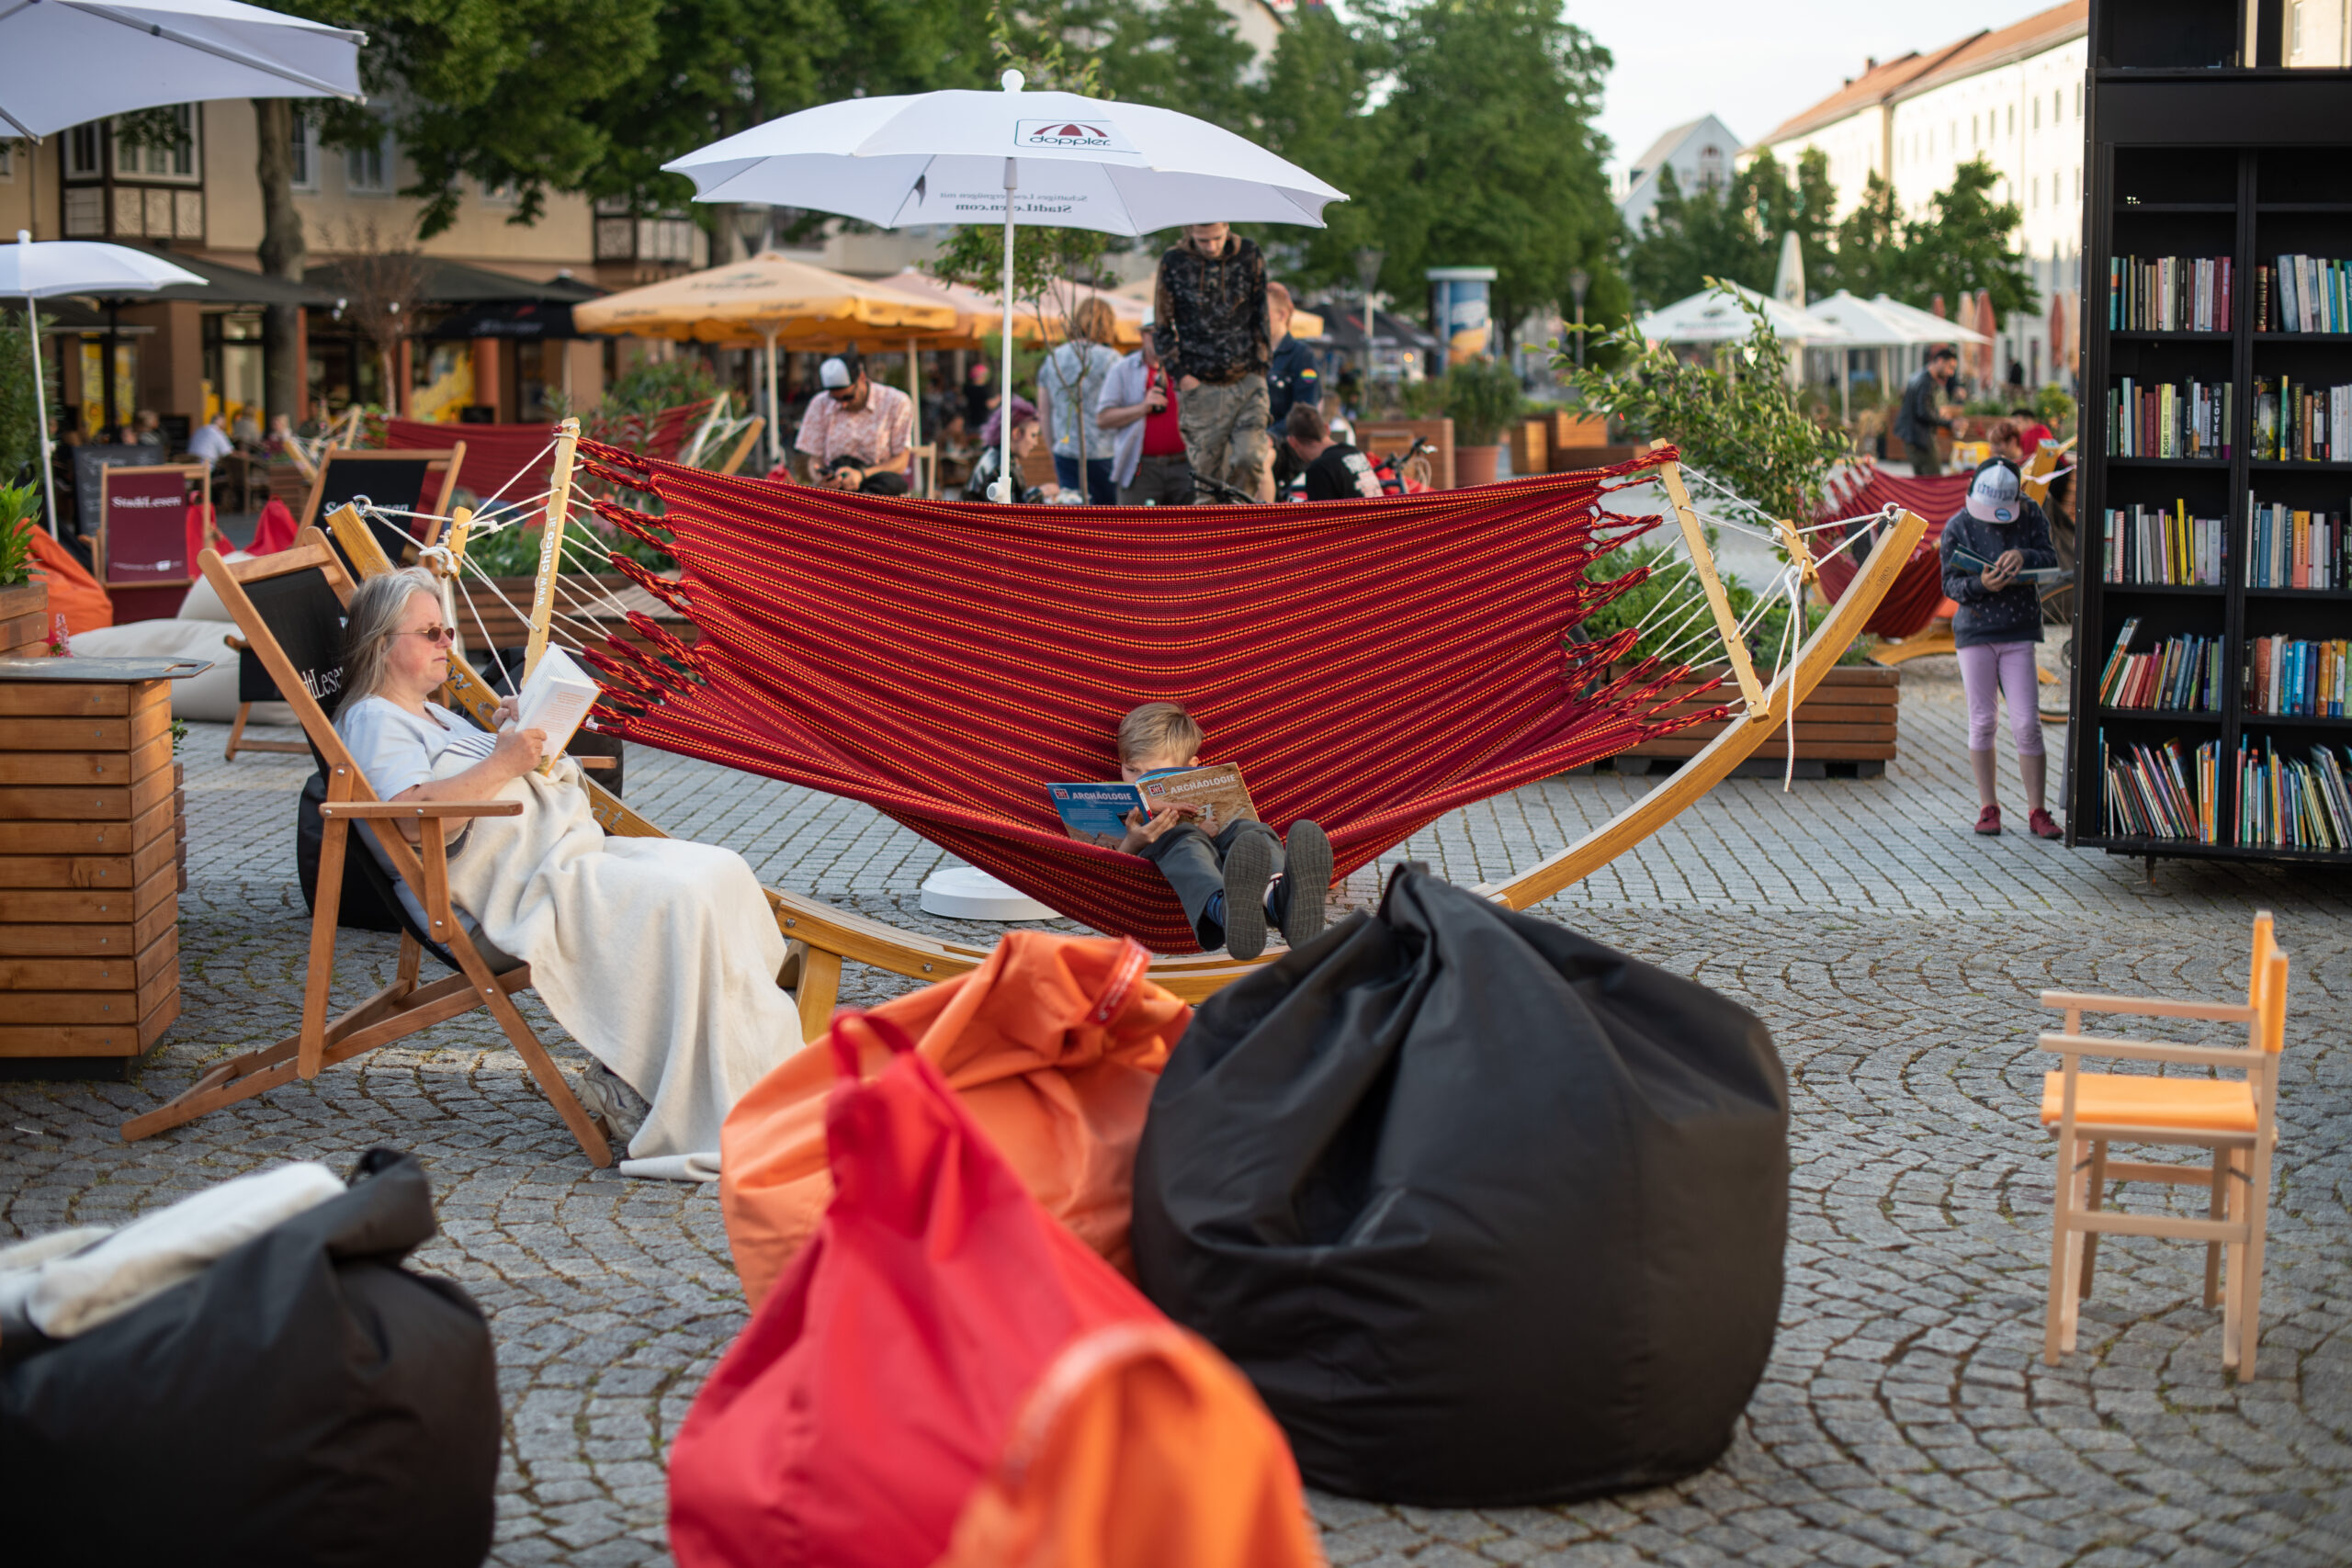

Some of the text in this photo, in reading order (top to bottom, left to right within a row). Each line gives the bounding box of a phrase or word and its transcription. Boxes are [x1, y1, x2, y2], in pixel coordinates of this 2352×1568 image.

[1030, 136, 1110, 147] doppler
[536, 515, 559, 607] www.chico.at
[1170, 774, 1237, 795] ARCHÄOLOGIE
[1072, 790, 1133, 802] ARCHÄOLOGIE
